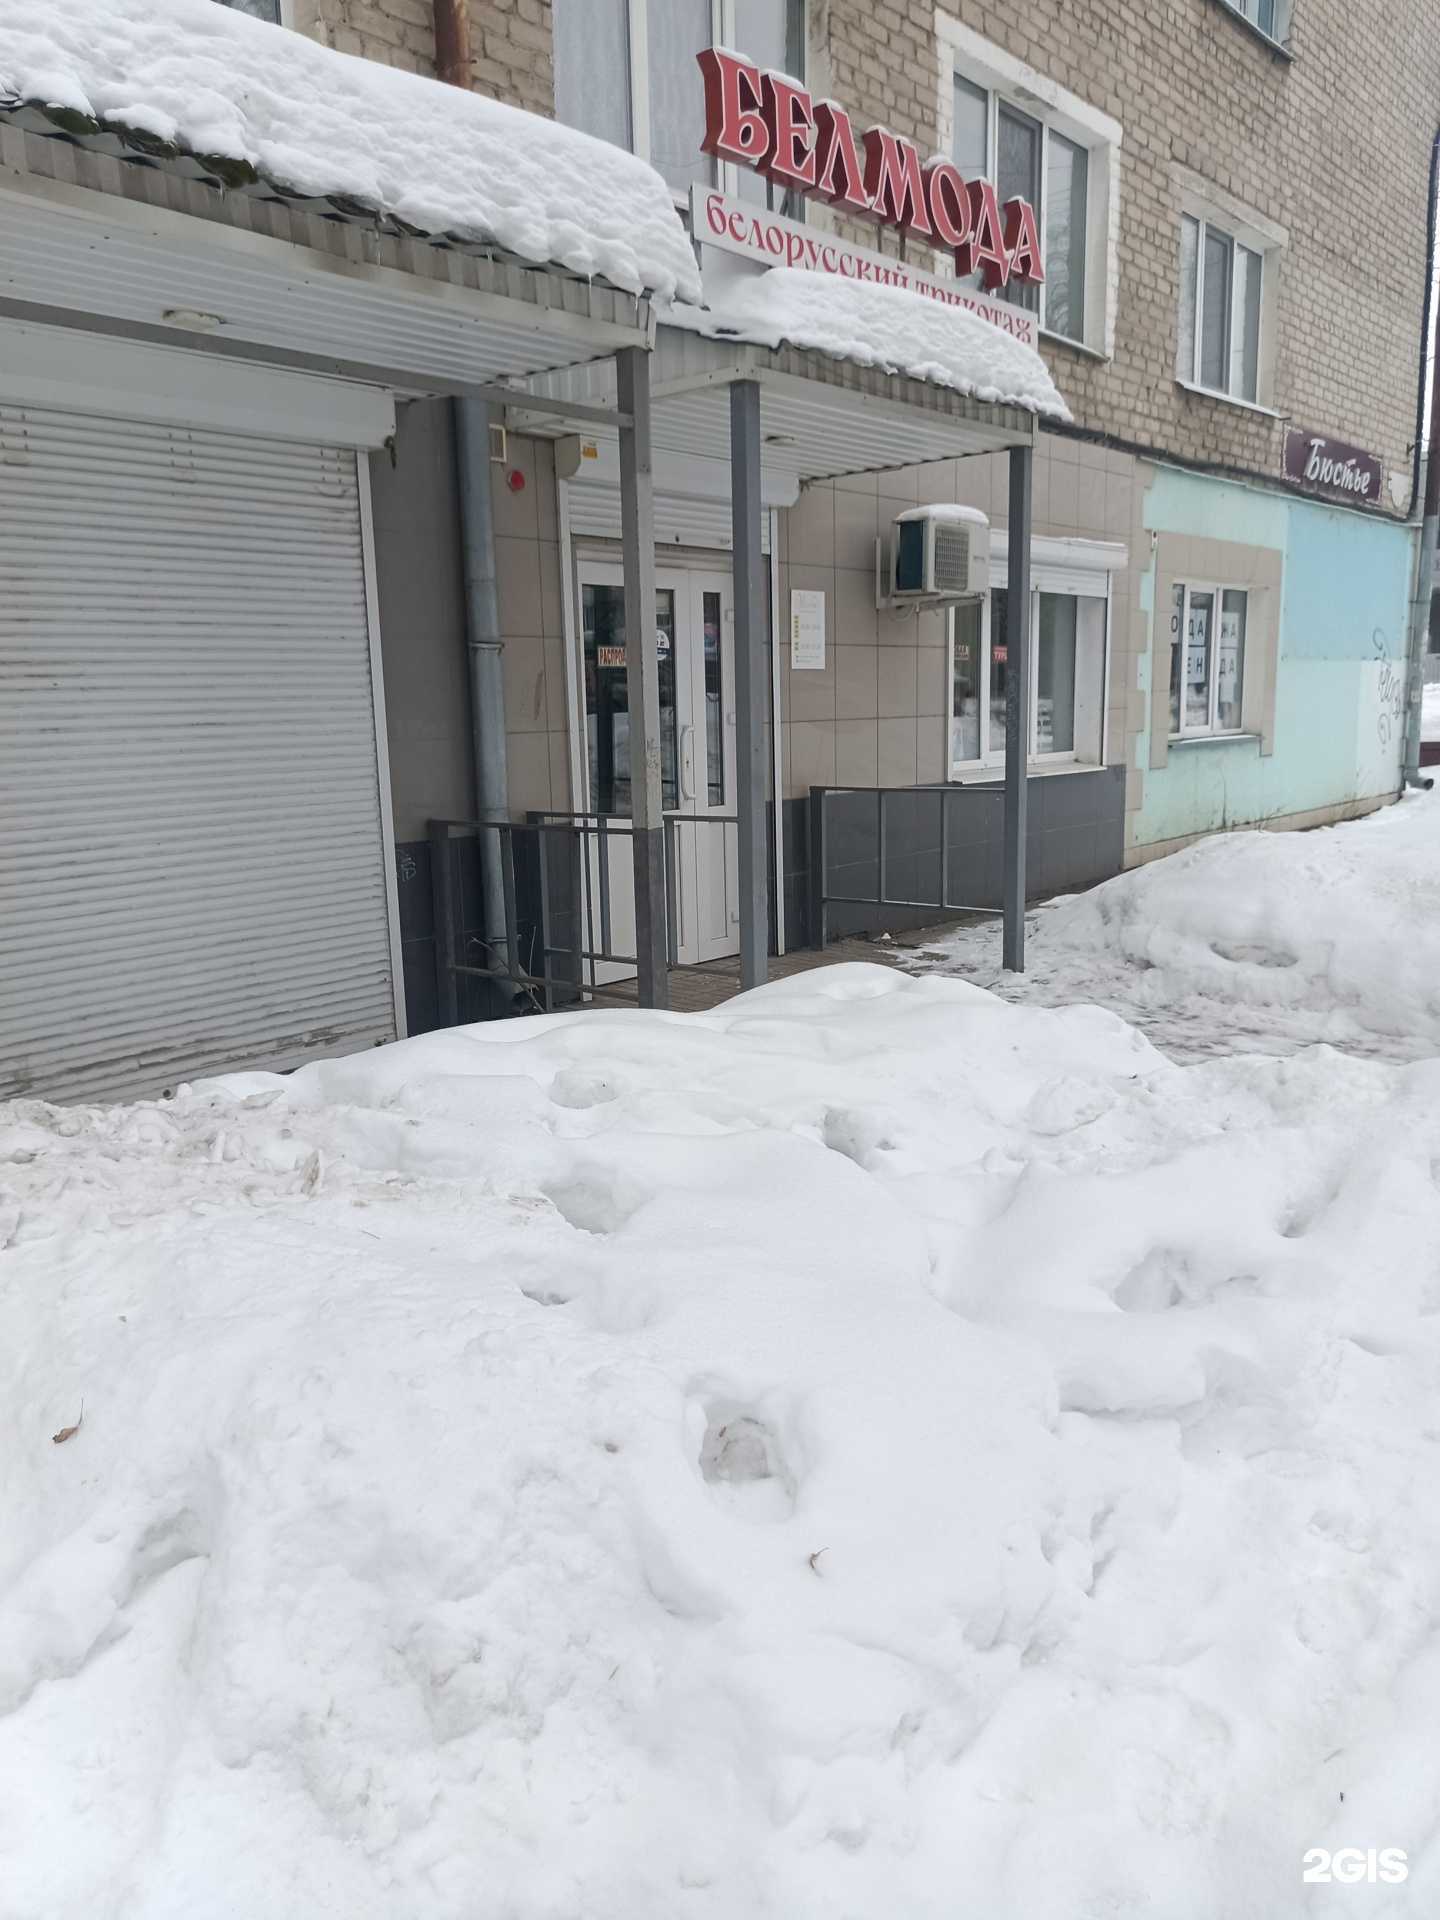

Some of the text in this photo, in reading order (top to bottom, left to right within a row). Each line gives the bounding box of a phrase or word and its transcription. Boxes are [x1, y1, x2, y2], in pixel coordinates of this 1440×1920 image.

[698, 48, 1045, 289] БЕЛМОДА
[705, 193, 909, 290] белорусский
[1304, 438, 1371, 495] Бюстье
